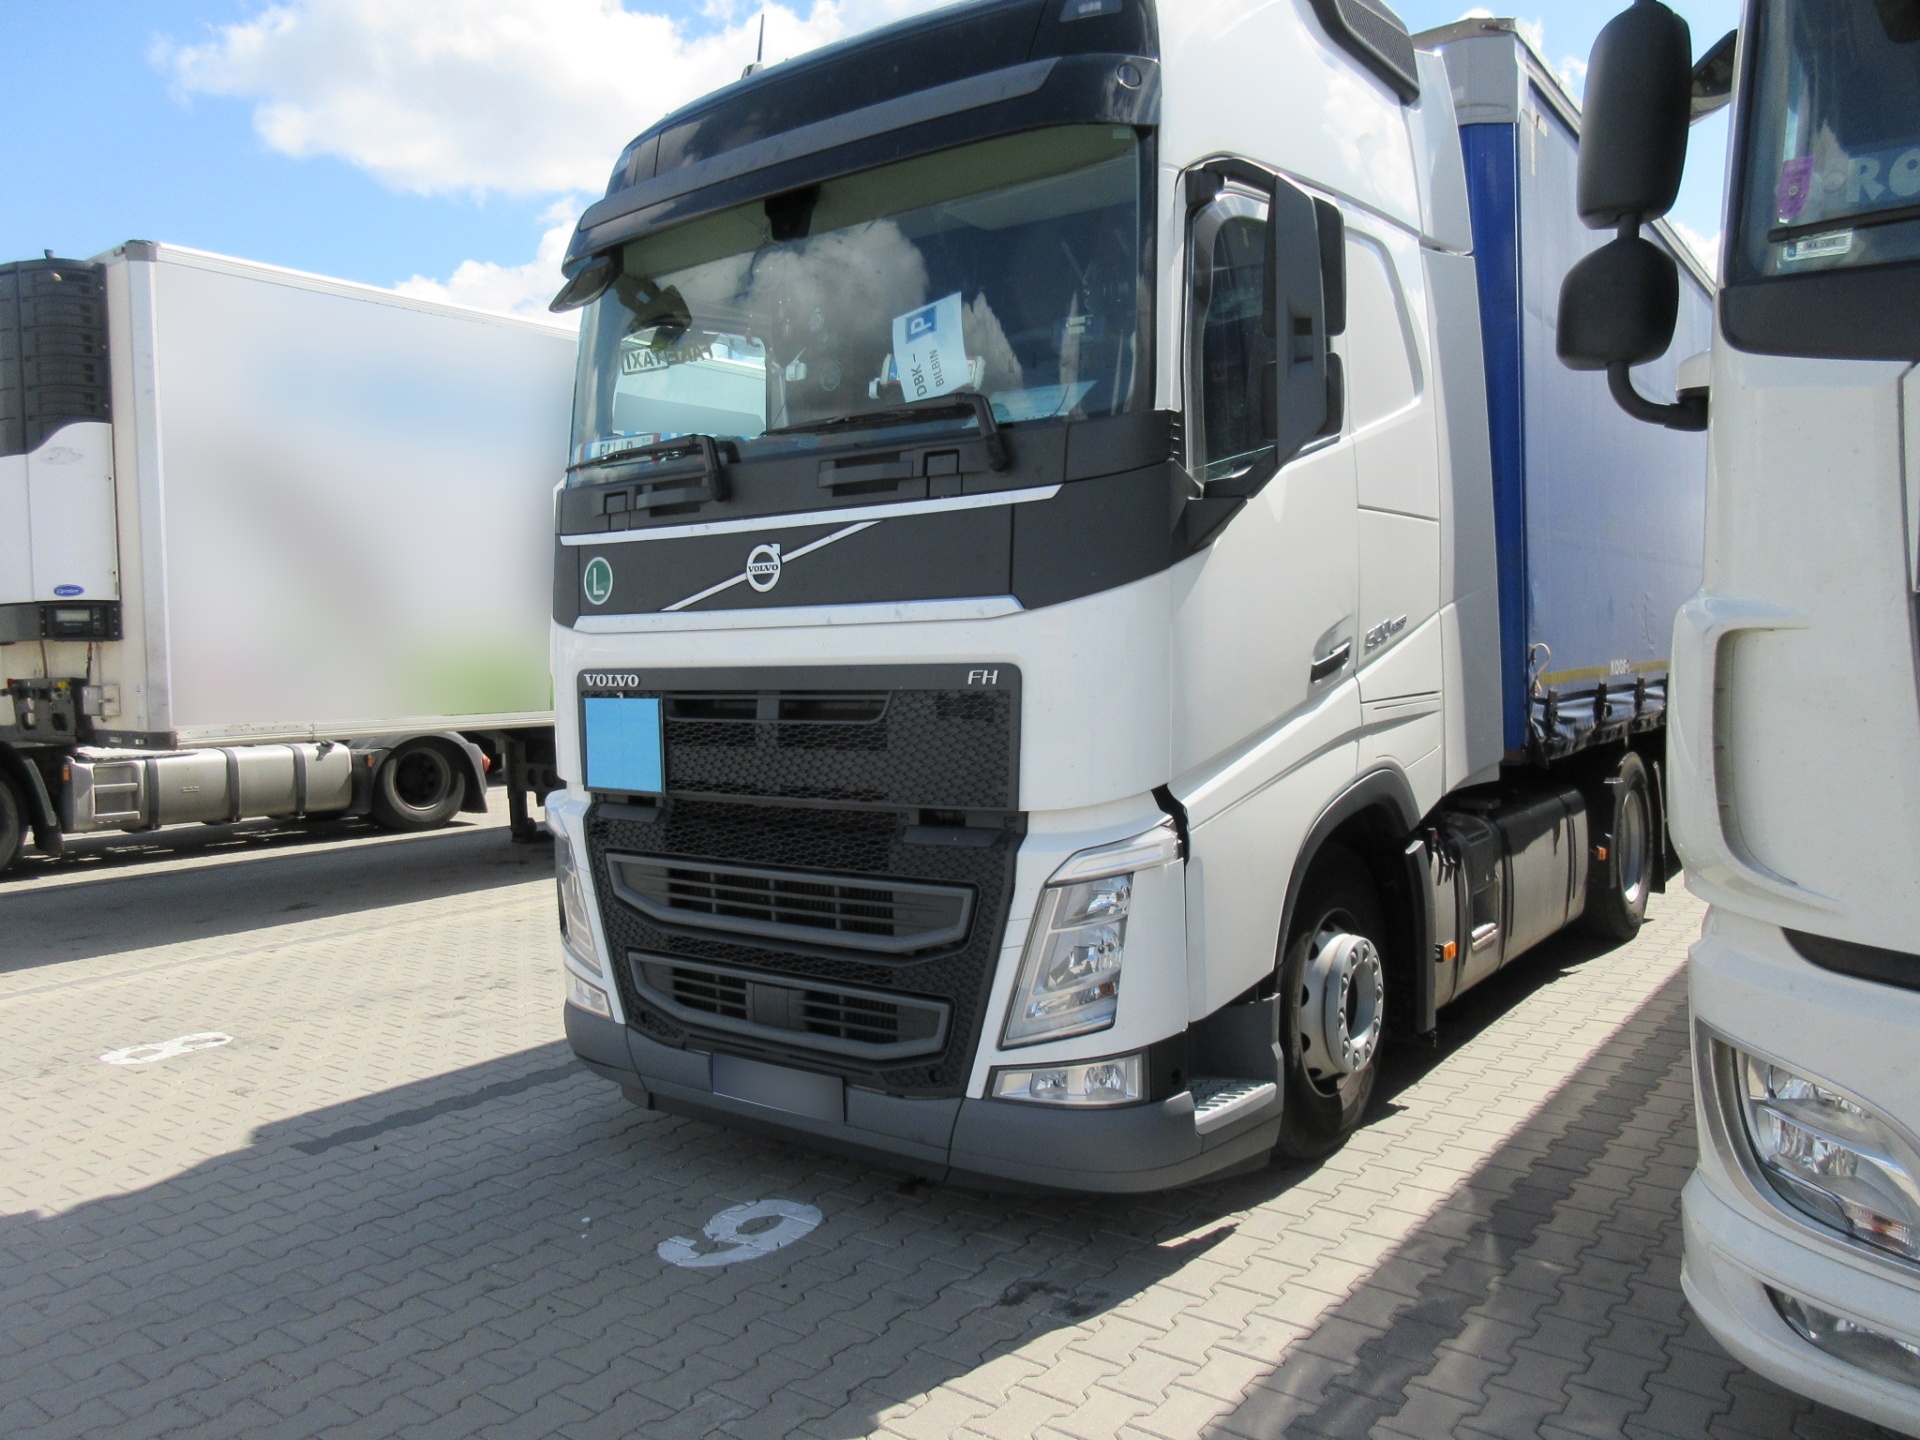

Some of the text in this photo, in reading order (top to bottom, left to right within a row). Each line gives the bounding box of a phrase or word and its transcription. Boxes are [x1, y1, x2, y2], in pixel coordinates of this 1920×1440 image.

[911, 317, 932, 334] P
[911, 364, 928, 397] DBK
[929, 349, 945, 387] BILBIN
[593, 567, 605, 595] L
[748, 564, 779, 573] VOLVO
[584, 673, 640, 687] VOLVO
[967, 669, 999, 685] FH
[100, 1032, 234, 1064] 8
[657, 1199, 822, 1267] 9
